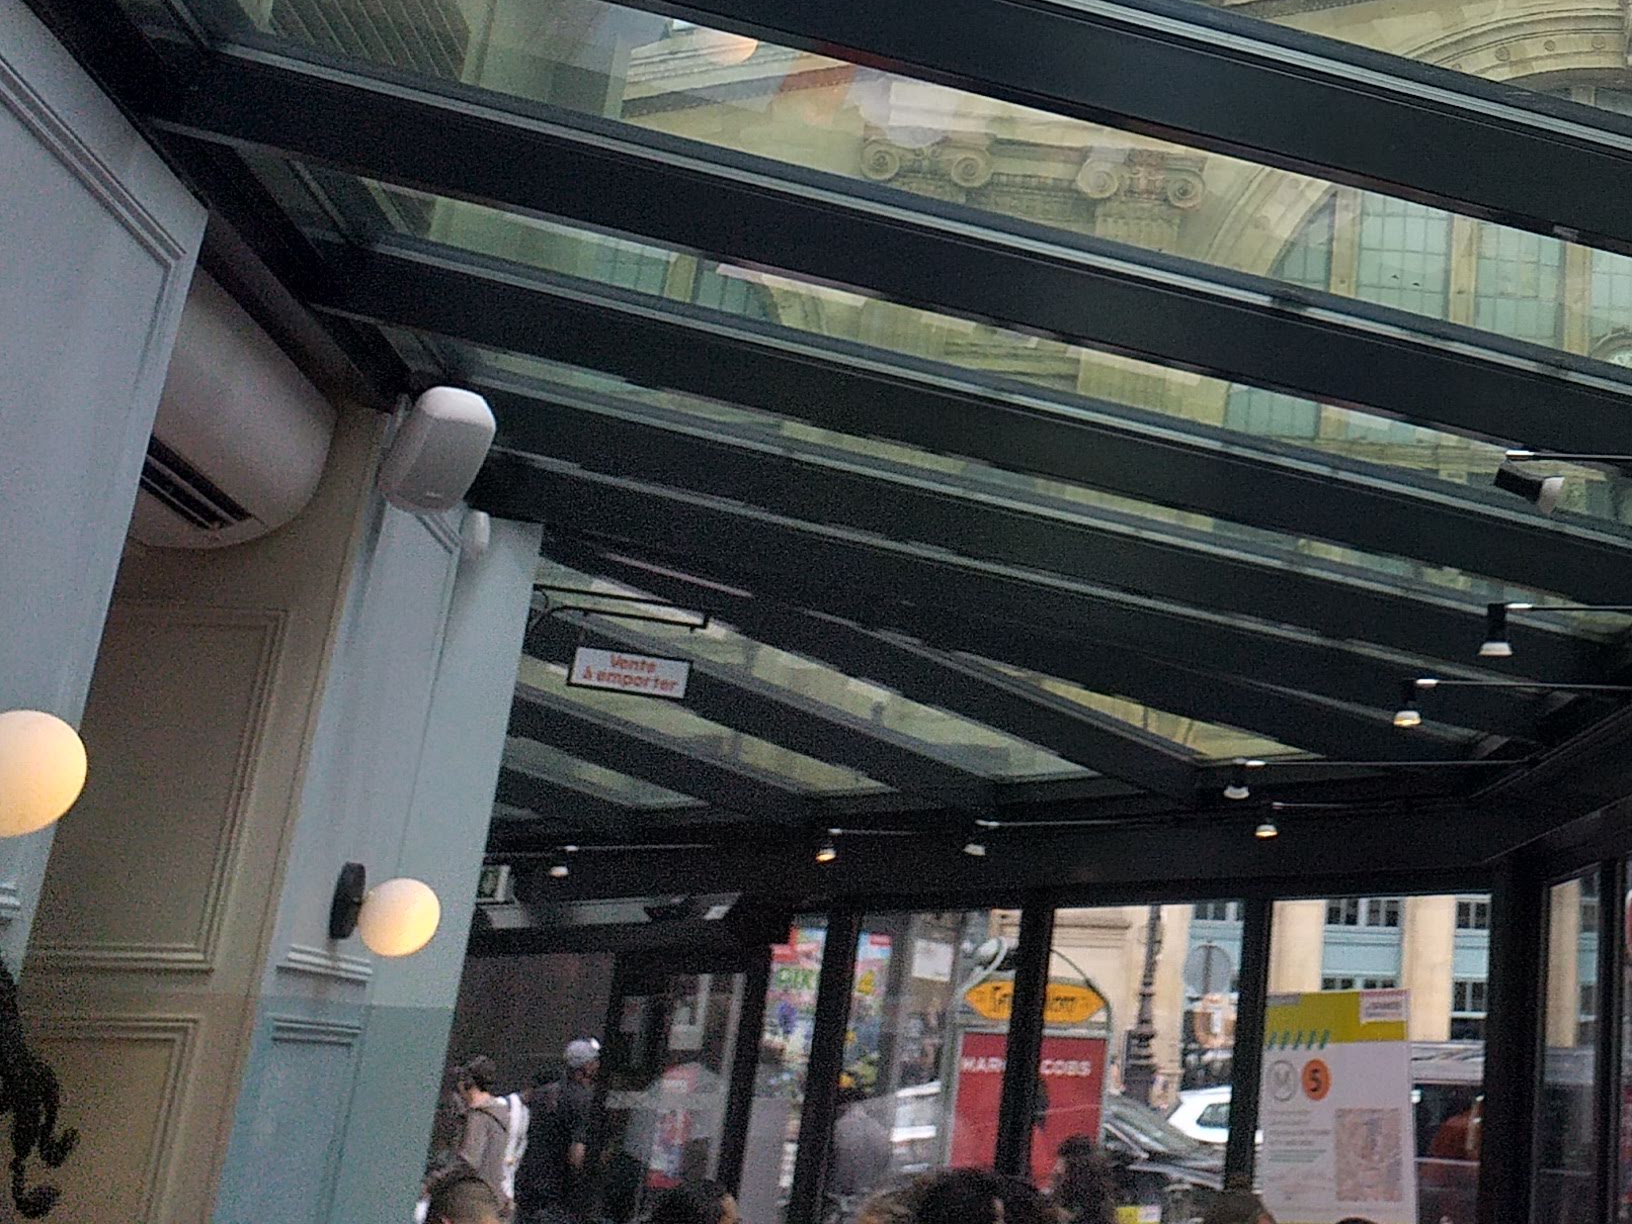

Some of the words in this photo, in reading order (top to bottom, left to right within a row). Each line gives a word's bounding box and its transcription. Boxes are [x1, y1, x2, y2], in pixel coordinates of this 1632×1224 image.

[609, 655, 656, 674] Vente
[596, 670, 679, 692] emporter
[960, 1056, 1006, 1073] MAR
[1040, 1059, 1092, 1077] COBS
[1310, 1067, 1323, 1094] 5
